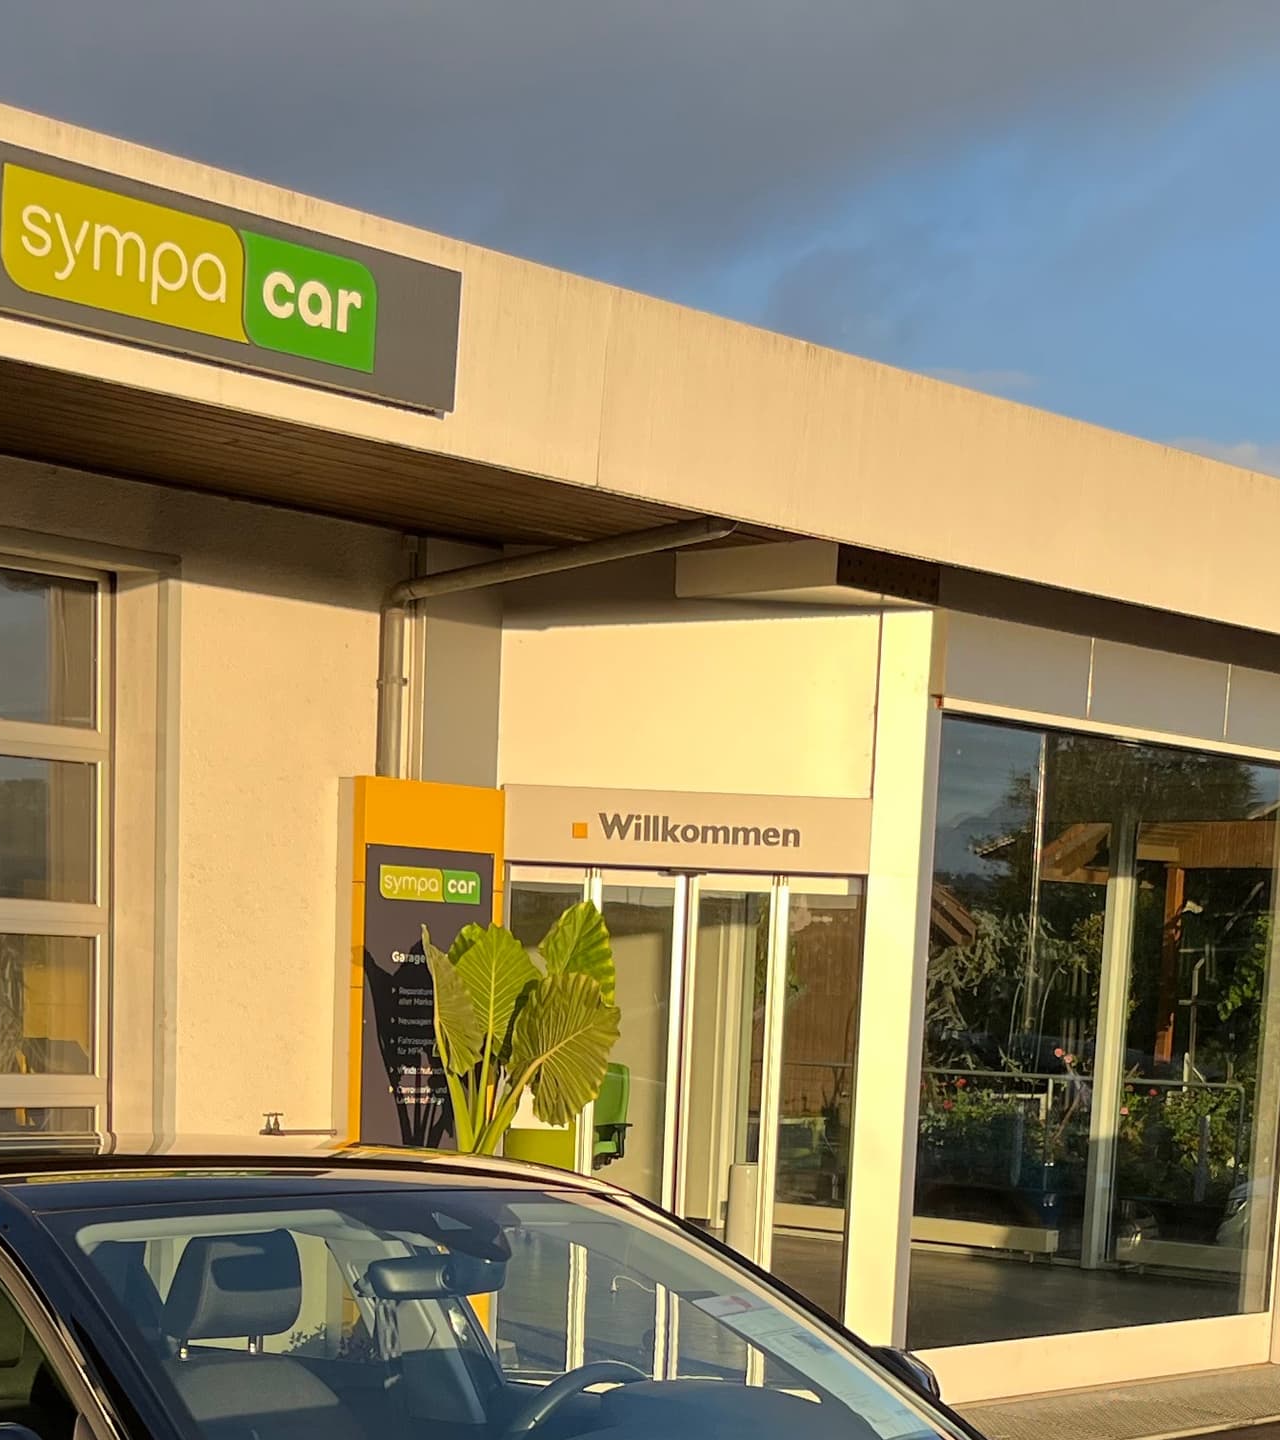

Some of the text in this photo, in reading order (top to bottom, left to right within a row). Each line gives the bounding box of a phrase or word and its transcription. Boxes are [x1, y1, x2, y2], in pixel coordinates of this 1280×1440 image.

[21, 204, 363, 333] sympa car
[598, 812, 801, 848] Willkommen
[383, 874, 477, 896] sympa car
[391, 950, 426, 965] Garage
